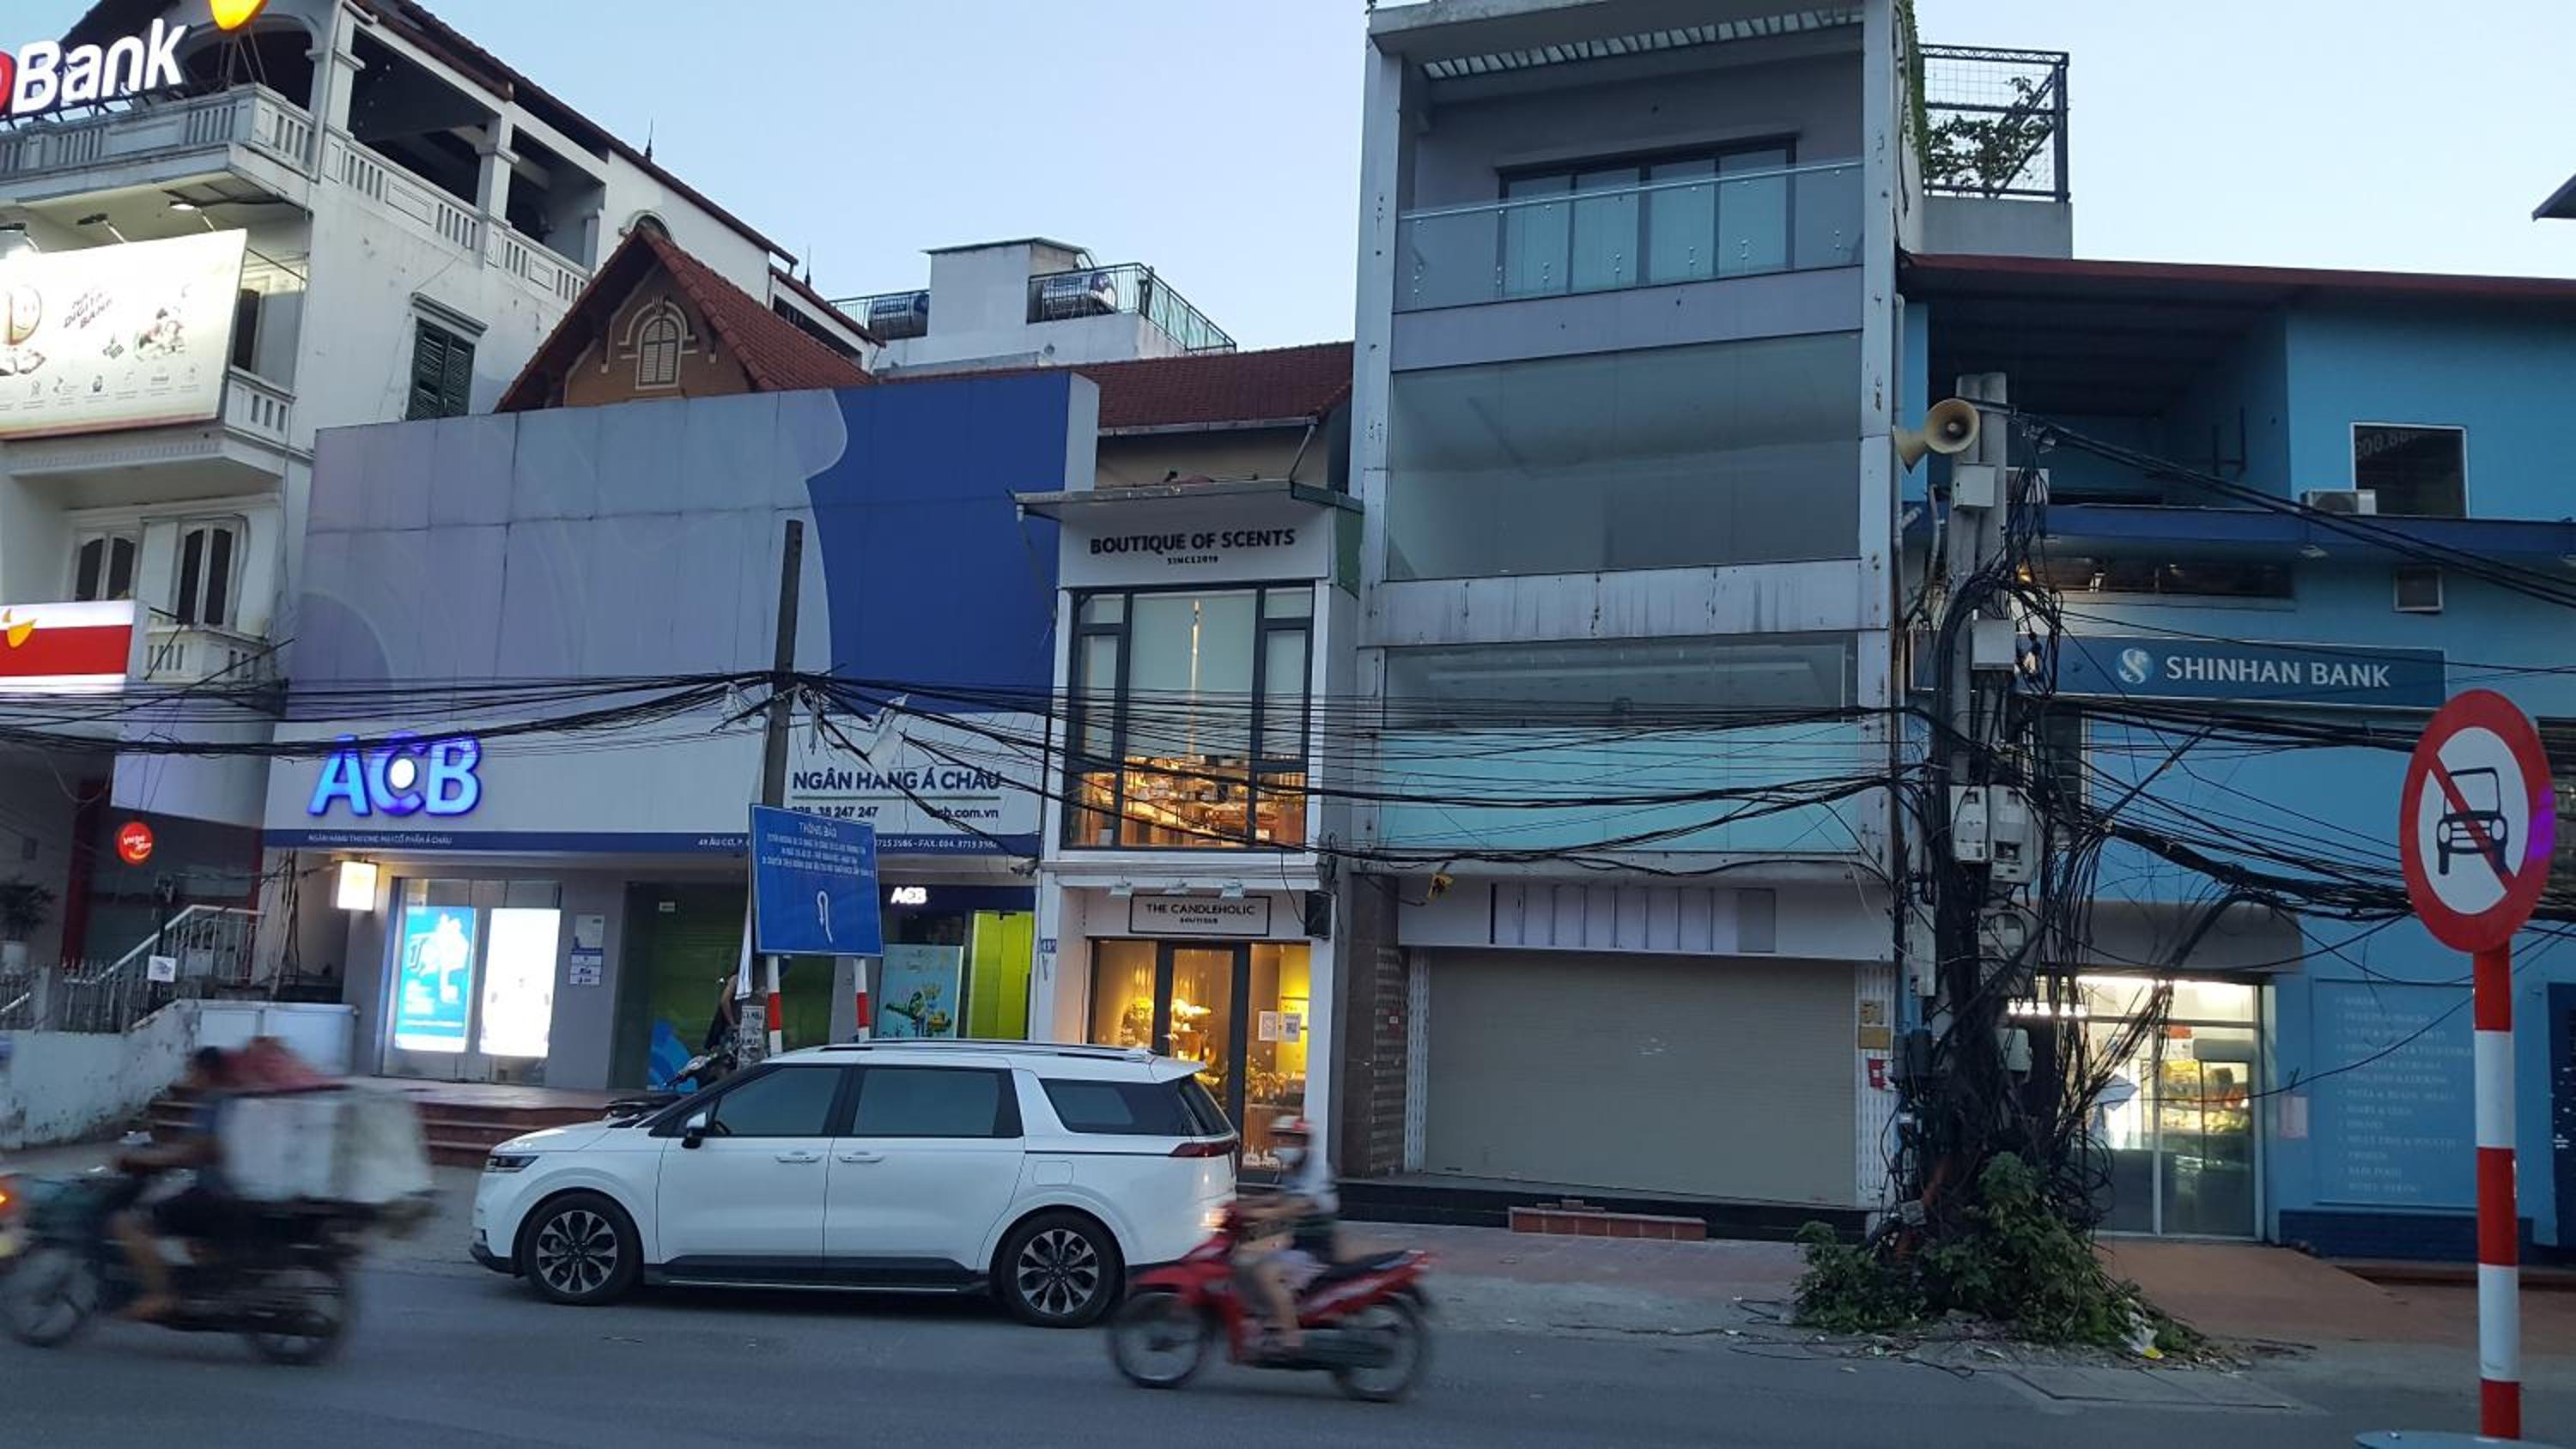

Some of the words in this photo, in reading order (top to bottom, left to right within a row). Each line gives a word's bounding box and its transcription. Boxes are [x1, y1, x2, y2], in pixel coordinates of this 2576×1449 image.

[1090, 533, 1187, 555] BOUTIQUE
[1191, 532, 1217, 550] OF
[1221, 528, 1297, 549] SCENTS
[2166, 655, 2302, 685] SHINHAN
[2310, 661, 2391, 688] BANK
[307, 731, 483, 817] ACB
[792, 766, 853, 791] NGÂN
[920, 766, 937, 790] Á
[834, 806, 856, 818] 247
[858, 806, 880, 818] 247
[1146, 903, 1168, 914] THE
[1171, 903, 1256, 916] CANDLEHOLIC
